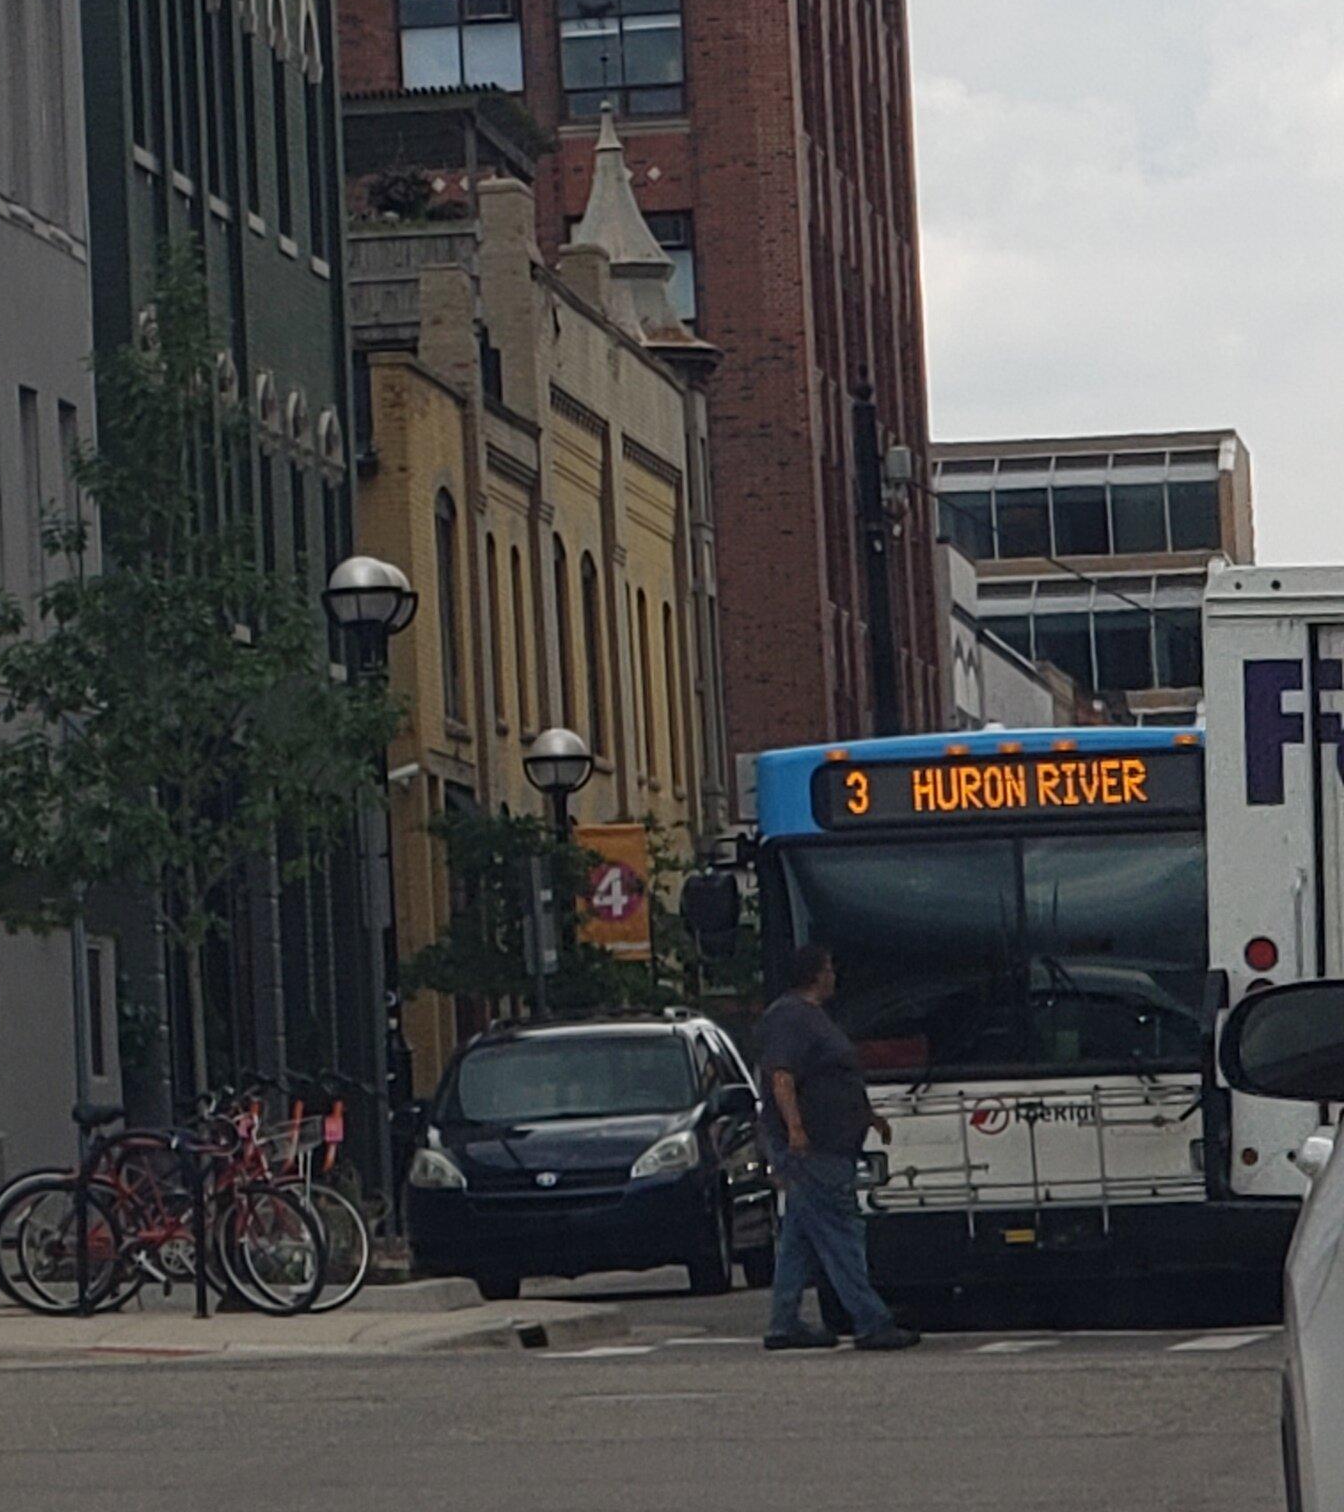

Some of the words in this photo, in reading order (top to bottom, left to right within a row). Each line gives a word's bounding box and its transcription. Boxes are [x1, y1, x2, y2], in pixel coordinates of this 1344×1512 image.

[845, 770, 869, 815] 3
[913, 764, 1027, 812] HURON
[1035, 758, 1149, 807] RIVER
[593, 867, 629, 917] 4
